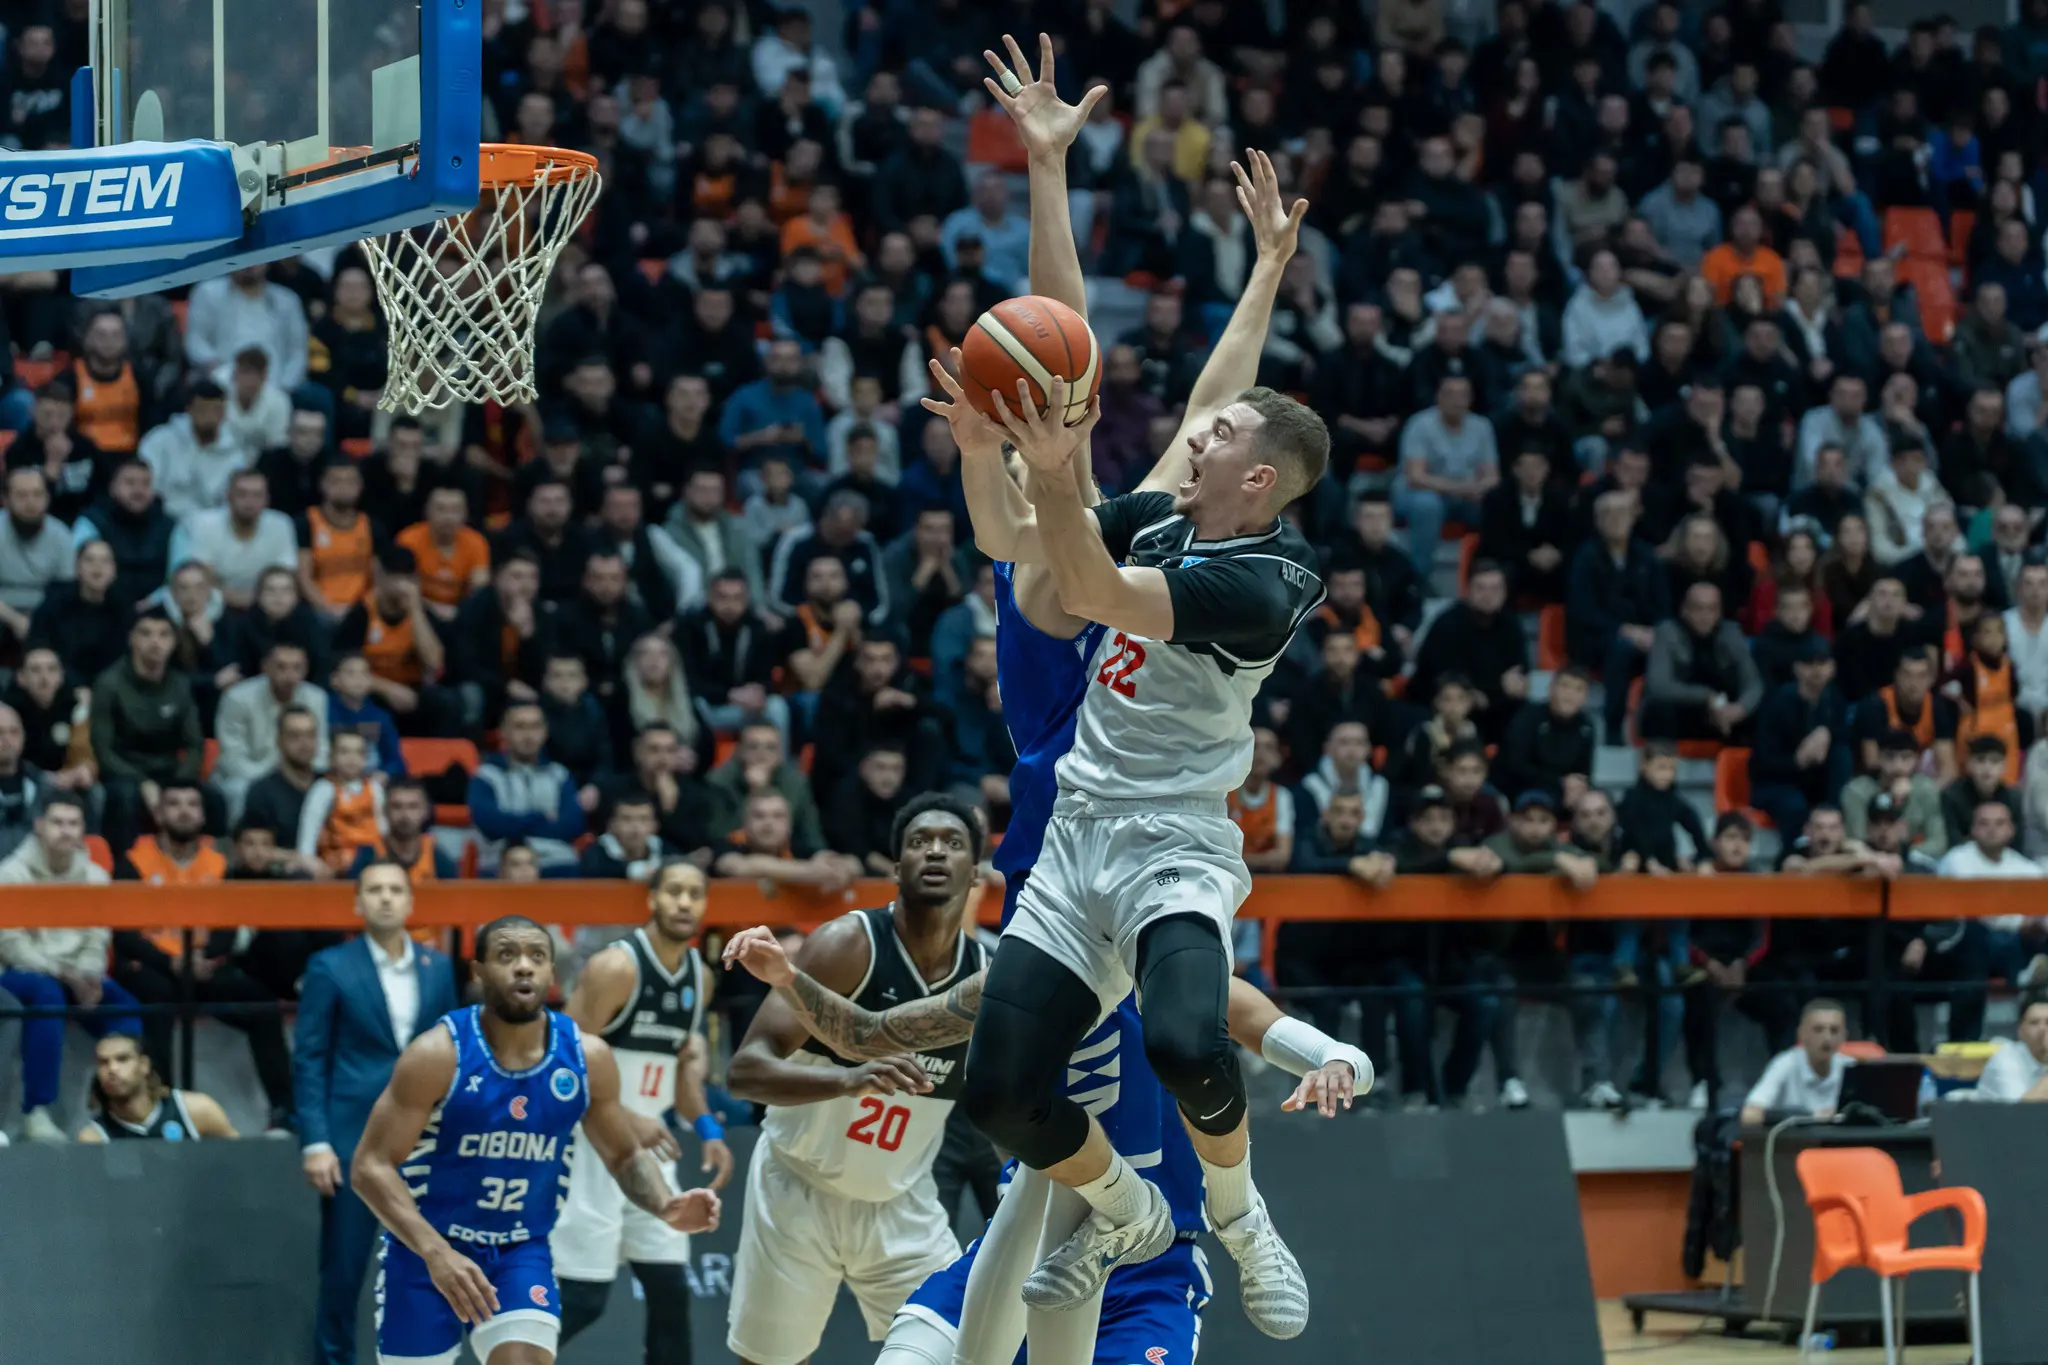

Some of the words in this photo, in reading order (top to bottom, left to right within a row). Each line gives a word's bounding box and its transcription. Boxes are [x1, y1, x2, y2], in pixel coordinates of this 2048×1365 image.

[1096, 631, 1147, 699] 22
[640, 1061, 663, 1097] 11
[846, 1096, 911, 1152] 20
[457, 1130, 558, 1162] CIBONA
[476, 1176, 529, 1212] 32
